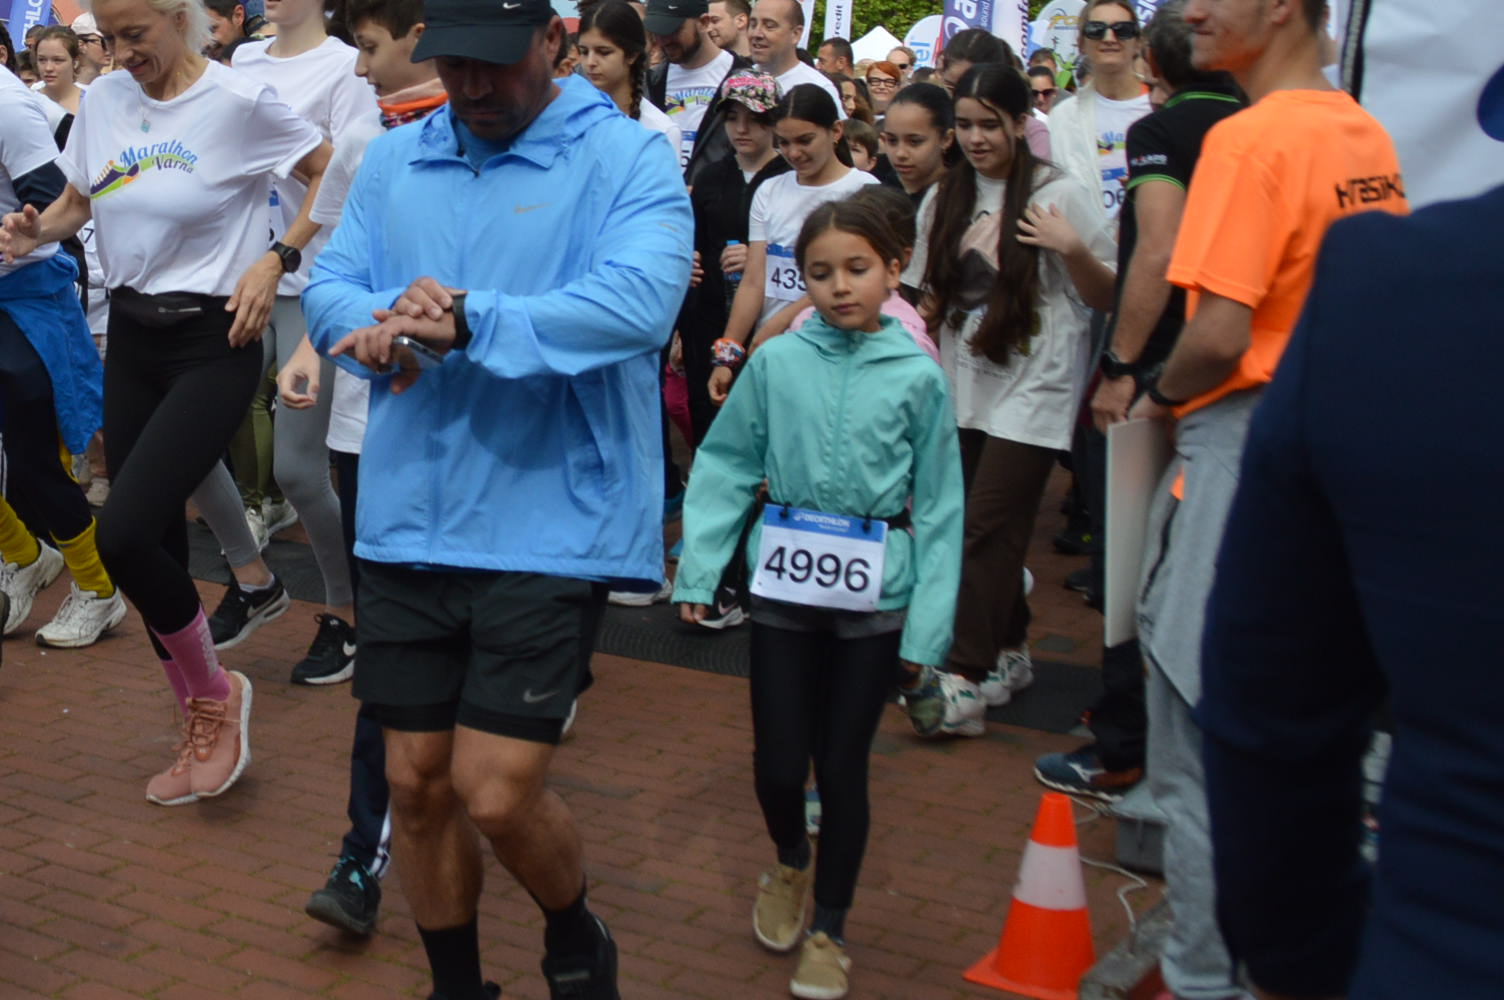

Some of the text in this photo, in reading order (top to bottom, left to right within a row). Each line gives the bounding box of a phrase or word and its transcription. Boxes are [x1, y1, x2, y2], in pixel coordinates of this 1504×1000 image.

[832, 4, 844, 38] redit
[120, 139, 198, 167] Marathon
[152, 155, 194, 174] Varna
[764, 546, 871, 592] 4996
